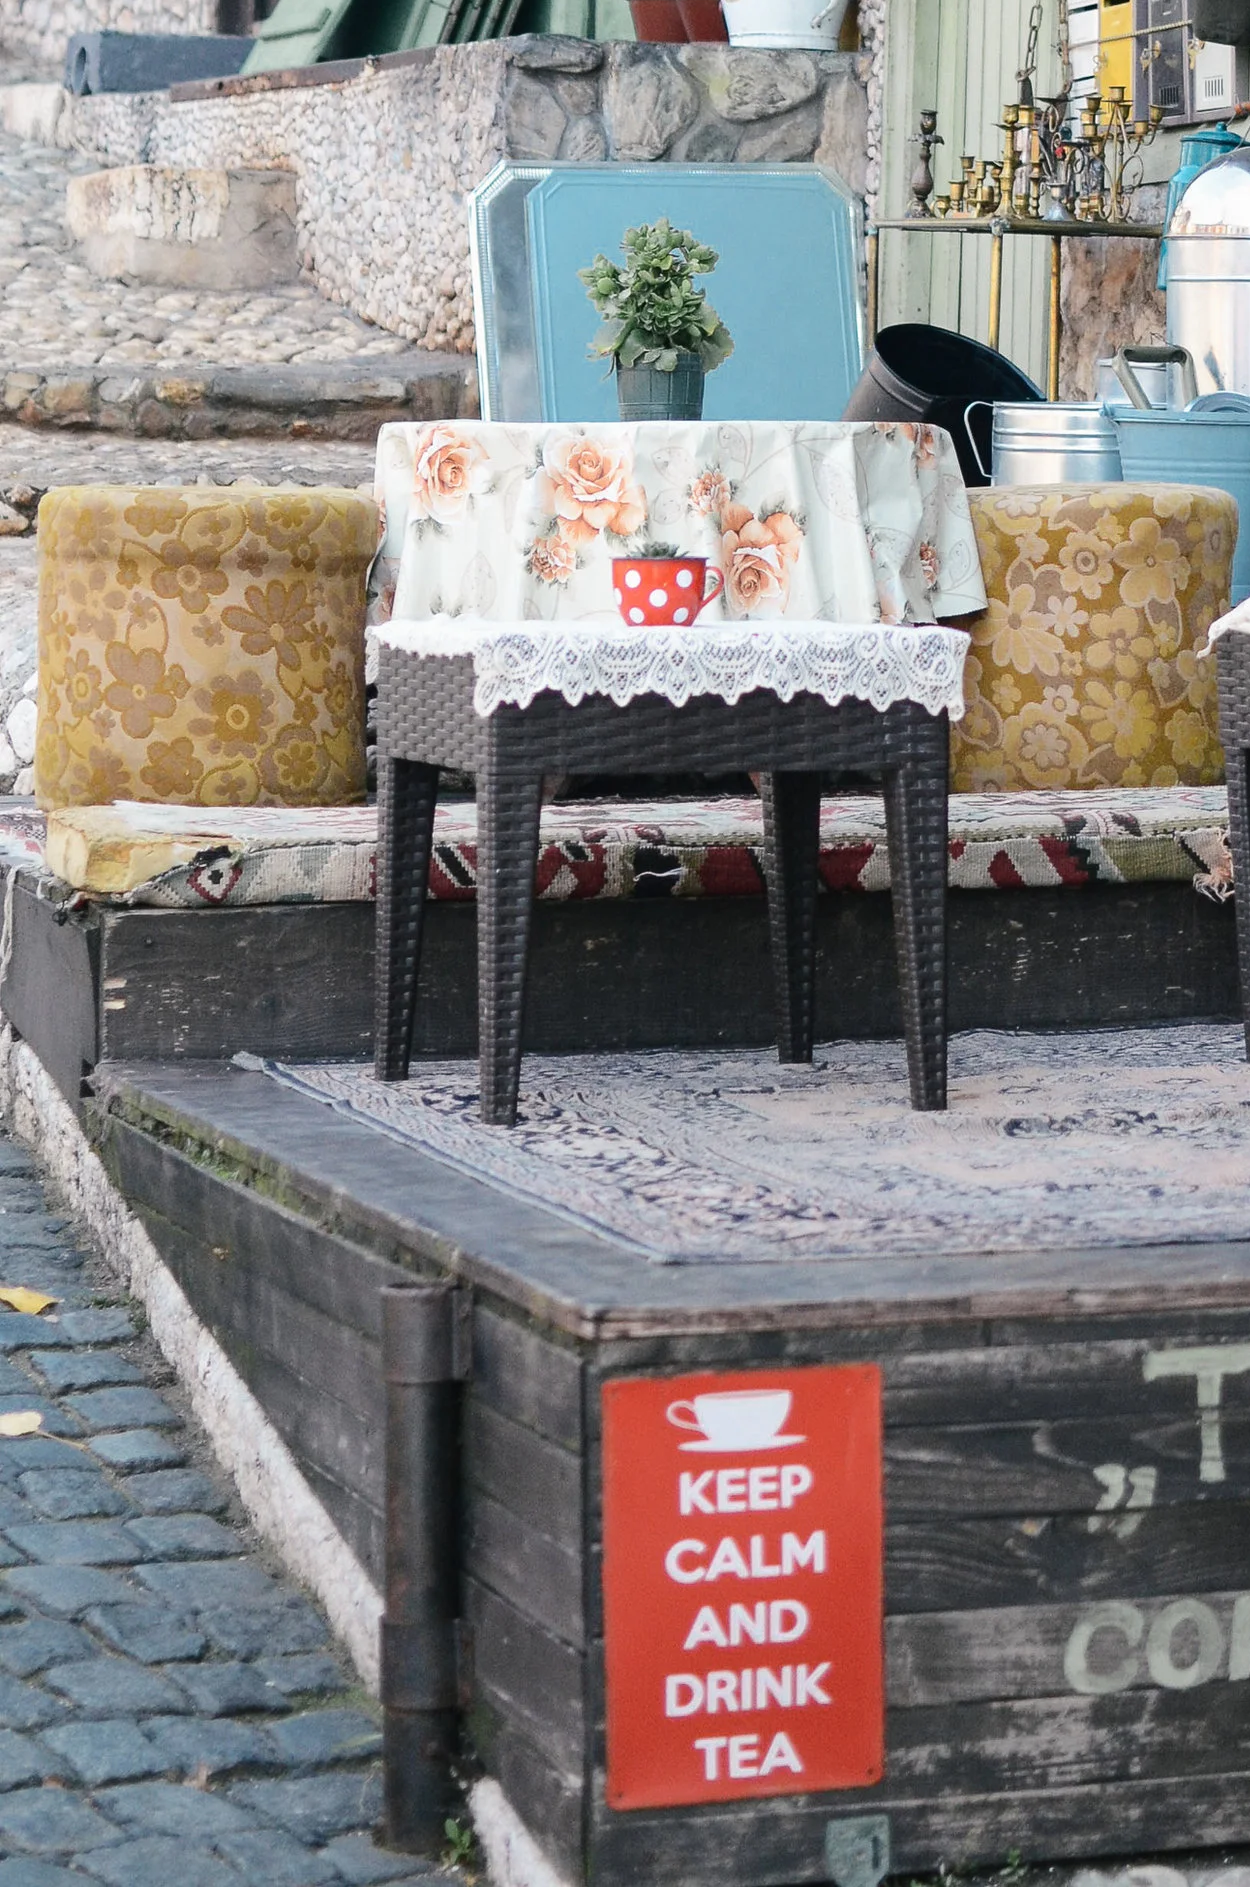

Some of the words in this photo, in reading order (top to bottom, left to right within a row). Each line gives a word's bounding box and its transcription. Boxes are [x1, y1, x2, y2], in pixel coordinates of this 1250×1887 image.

[678, 1464, 813, 1516] KEEP
[663, 1530, 827, 1585] CALM
[683, 1600, 811, 1652] AND
[664, 1662, 833, 1719] DRINK
[694, 1731, 804, 1782] TEA
